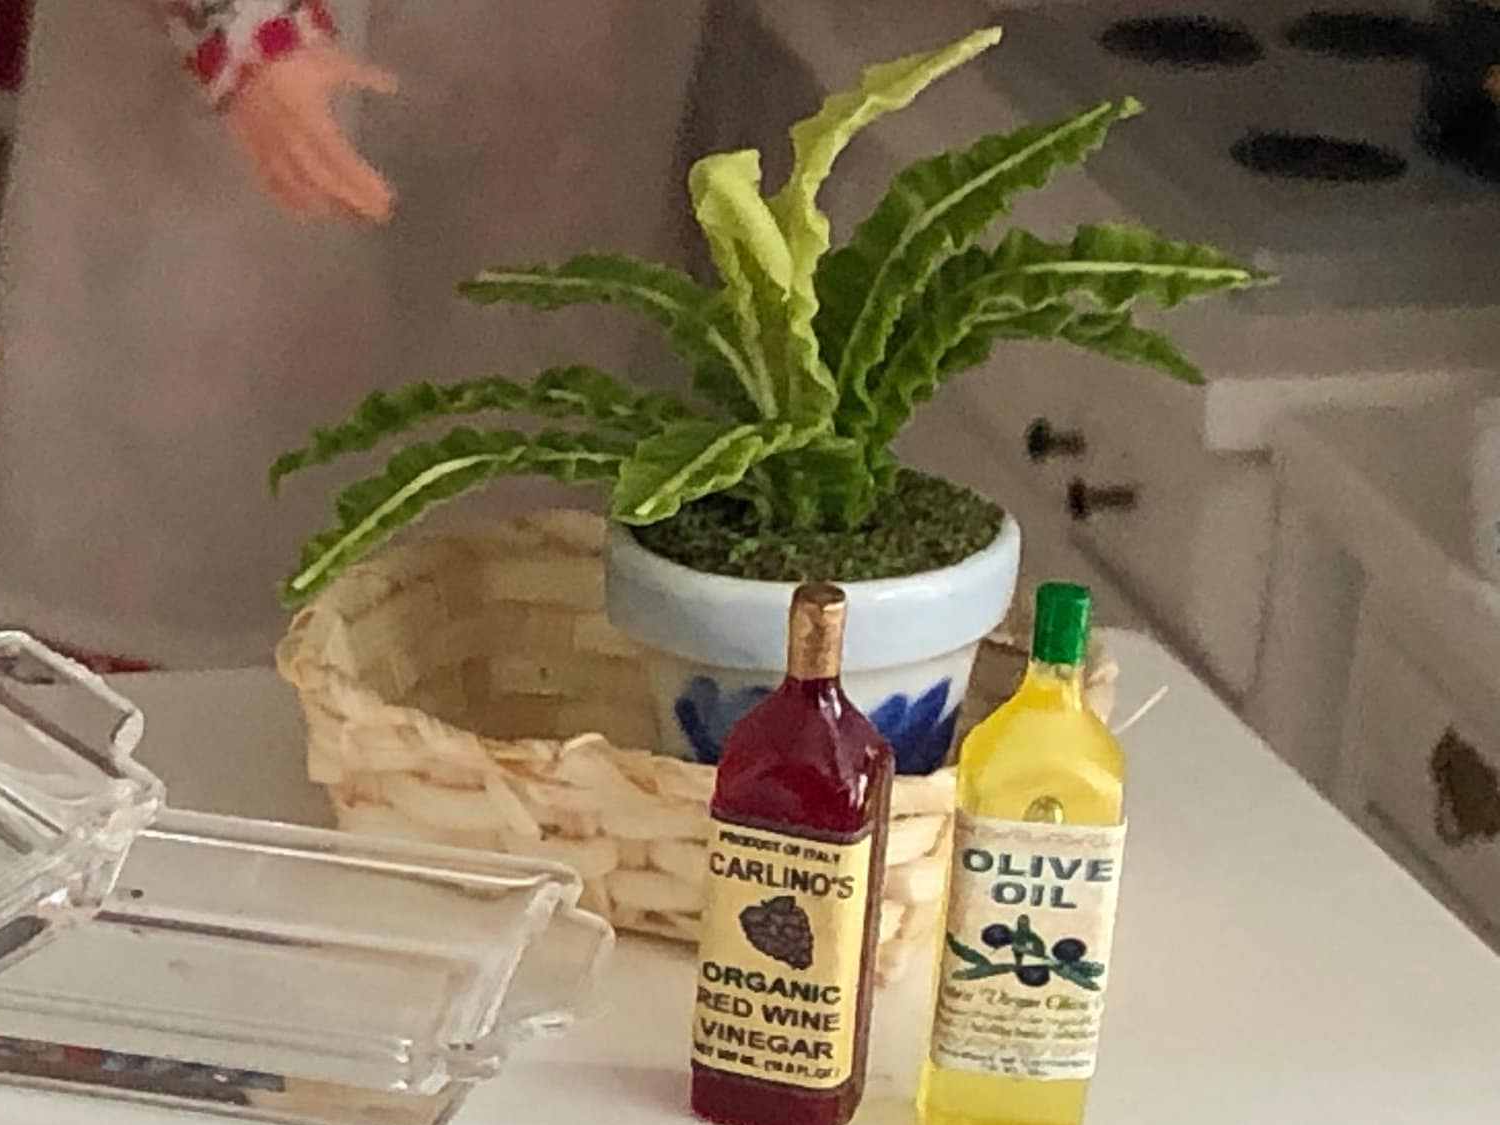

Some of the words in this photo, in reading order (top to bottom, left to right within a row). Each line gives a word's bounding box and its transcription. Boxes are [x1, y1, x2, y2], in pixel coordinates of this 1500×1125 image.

[709, 852, 855, 899] CARLINO'S
[962, 847, 1115, 883] OLIVE
[991, 881, 1078, 910] OIL
[702, 961, 842, 1005] ORGANIC
[696, 985, 754, 1018] RED
[761, 1004, 841, 1033] WINE
[700, 1017, 834, 1060] VINEGAR
